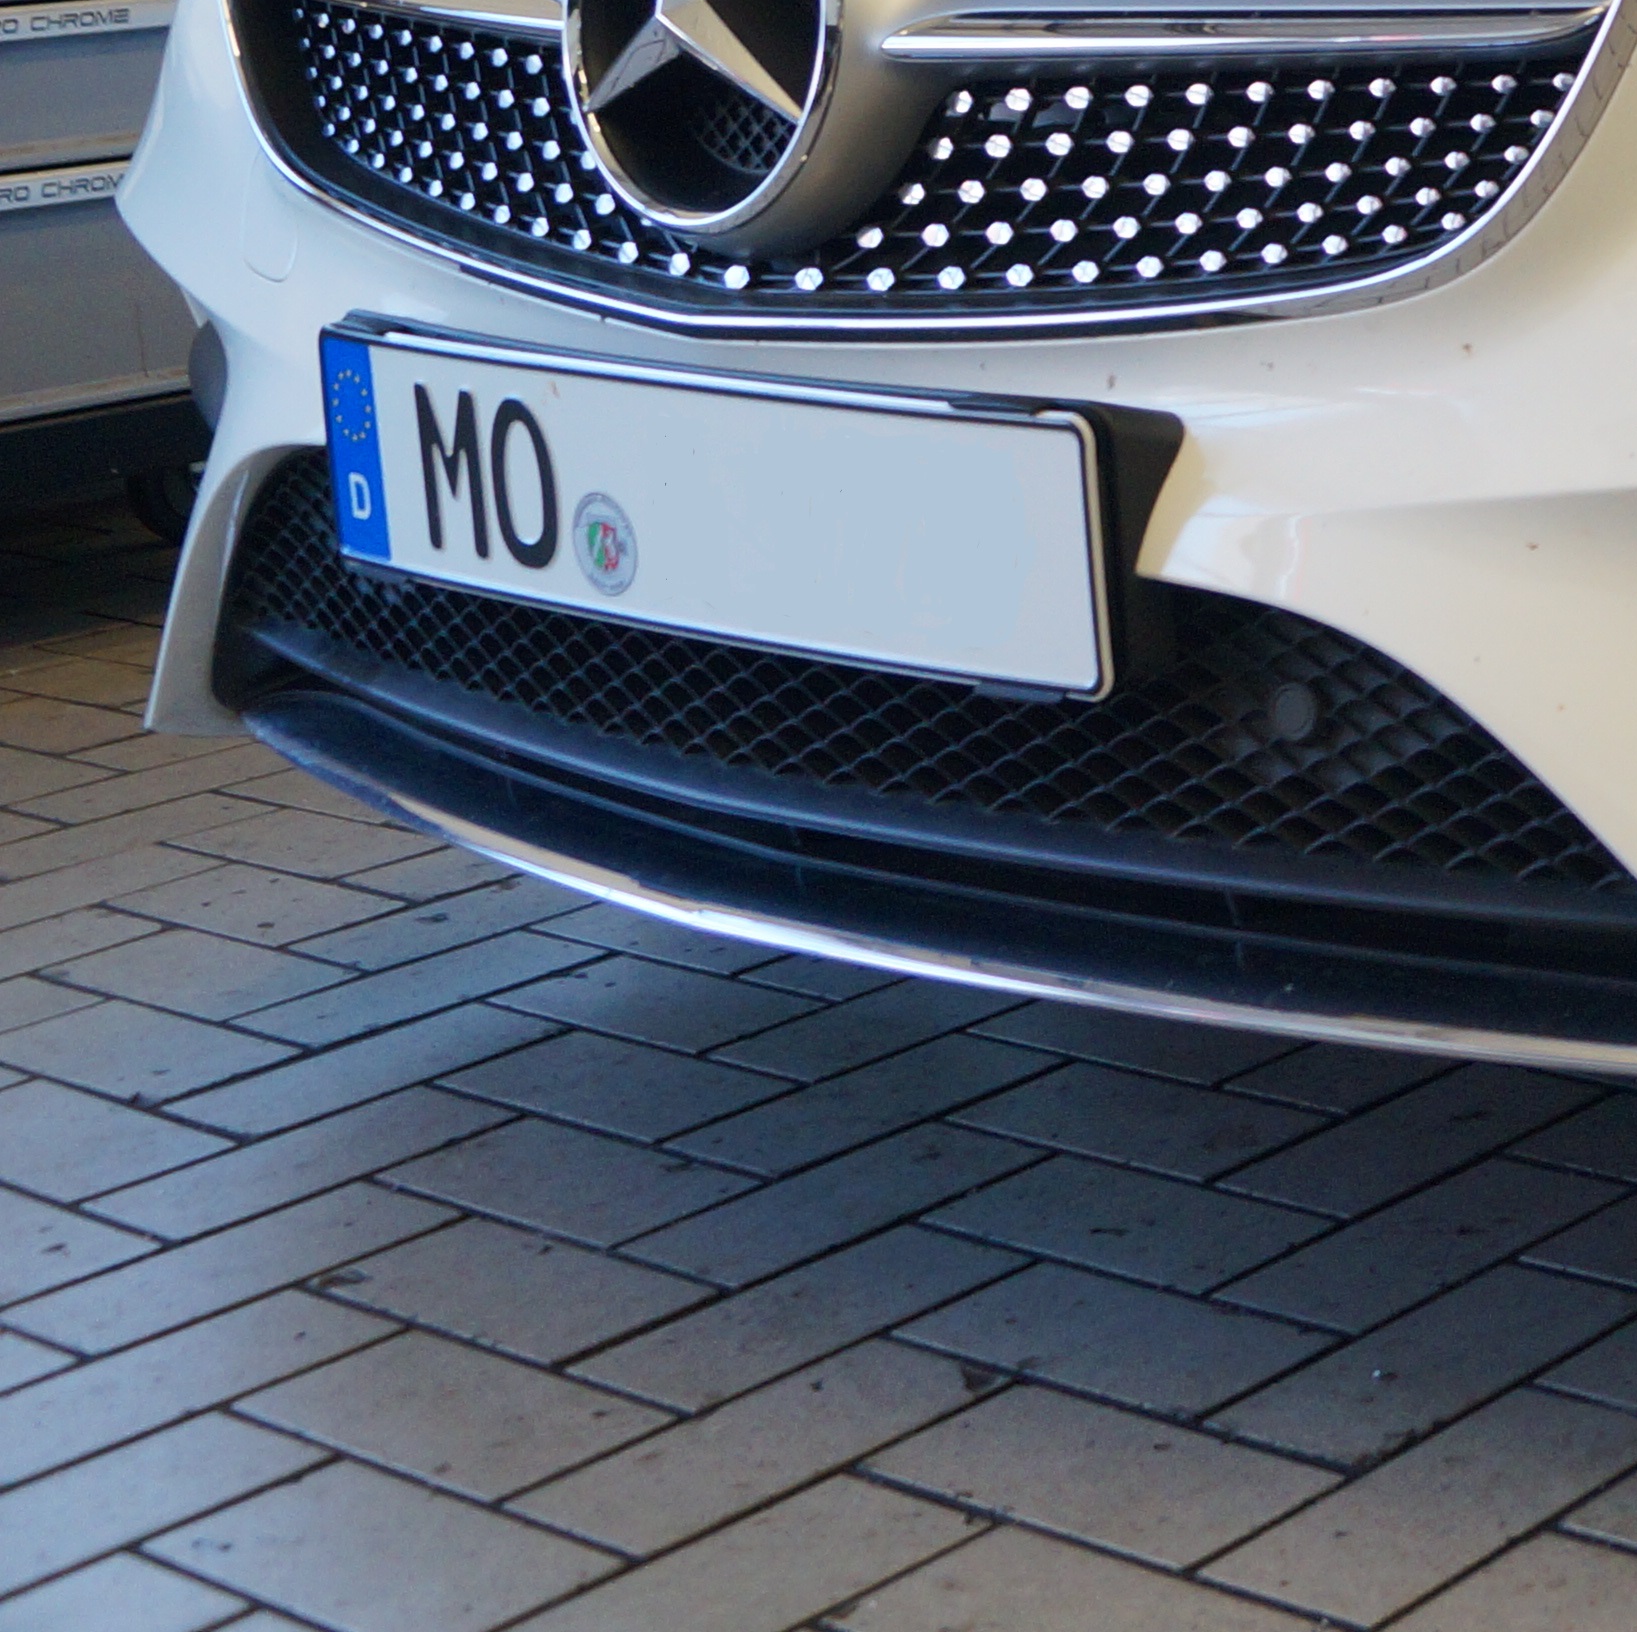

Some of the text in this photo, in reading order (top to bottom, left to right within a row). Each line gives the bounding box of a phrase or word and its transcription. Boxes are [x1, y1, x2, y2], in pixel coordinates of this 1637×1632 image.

[30, 8, 130, 32] CHROME
[41, 173, 125, 199] CHROM
[414, 382, 560, 569] MO
[348, 471, 372, 521] D
